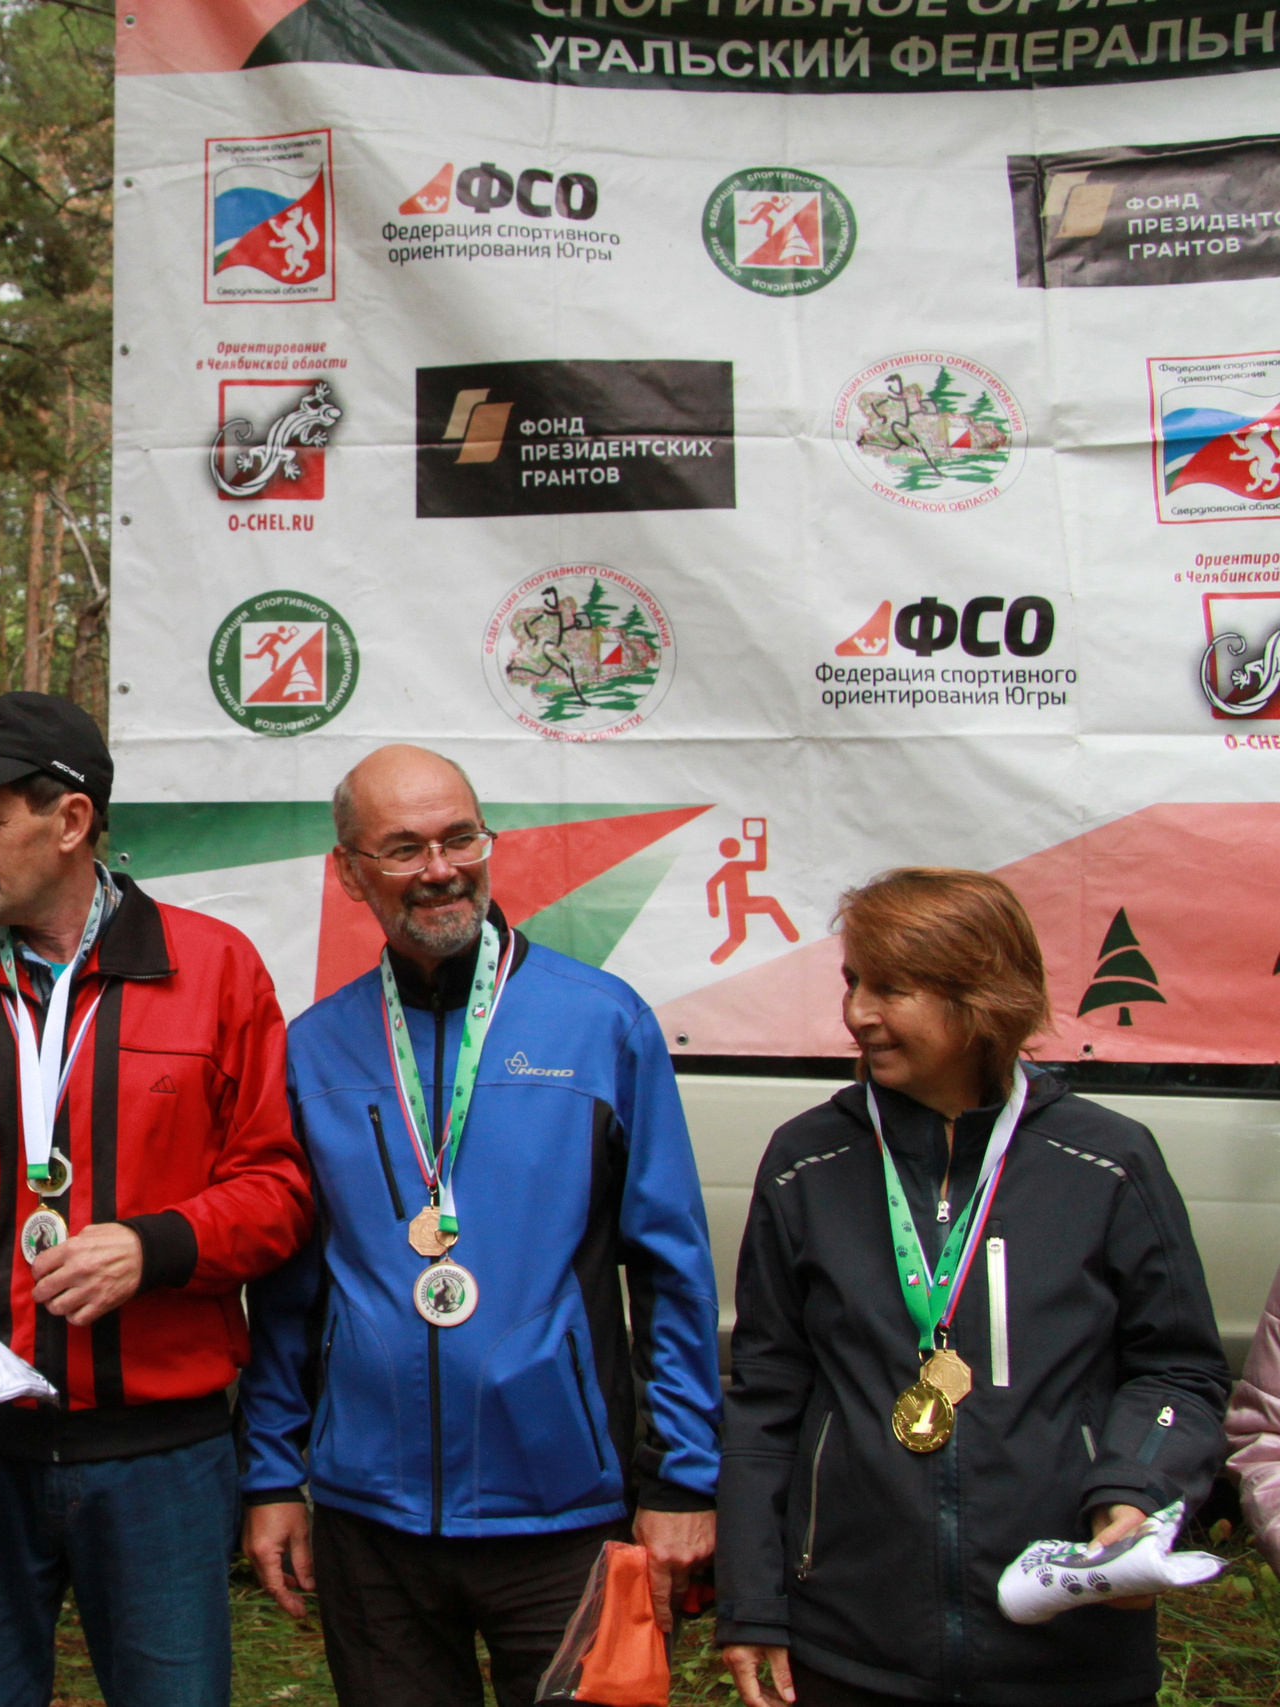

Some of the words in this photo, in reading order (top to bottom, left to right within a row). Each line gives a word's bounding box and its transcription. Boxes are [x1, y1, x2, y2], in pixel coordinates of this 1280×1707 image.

[531, 27, 870, 78] УРАЛЬСКИЙ
[890, 10, 1277, 82] ФЕДЕРАЛЬН
[456, 162, 598, 220] ФСО
[709, 180, 741, 229] ФЕДЕРАЦИЯ
[747, 171, 822, 189] СПОРТИВНОГО
[1126, 192, 1199, 210] ФОНД
[382, 222, 492, 243] Федерация
[497, 224, 620, 245] спортивного
[388, 243, 551, 267] ориентирования
[557, 242, 612, 263] Югры
[1128, 237, 1241, 260] ГРАНТОВ
[217, 341, 327, 356] Ориентирование
[196, 360, 203, 370] в
[207, 356, 289, 370] Челябинской
[292, 357, 347, 370] области
[1159, 363, 1220, 374] Федерация
[1177, 371, 1266, 384] ориентирования
[835, 378, 862, 428] ФЕДЕРАЦИЯ
[861, 353, 944, 380] СПОРТИВНОГО
[946, 356, 1022, 432] ОРИЕНТИРОВАНИЯ
[520, 417, 585, 436] ФОНД
[521, 440, 713, 461] ПРЕЗИДЕНТСКИХ
[521, 467, 620, 487] ГРАНТОВ
[872, 482, 946, 512] КУРГАНСКОЙ
[949, 486, 1001, 512] ОБЛАСТИ
[1171, 503, 1246, 515] Свердловской
[228, 514, 314, 531] O-CHEL.RU
[1195, 553, 1280, 569] Ориентиро
[1174, 573, 1181, 582] в
[1186, 567, 1280, 583] Челябинской
[485, 593, 518, 654] ФЕДЕРАЦИЯ
[519, 565, 597, 595] СПОРТИВНОГО
[599, 568, 671, 647] ОРИЕНТИРОВАНИЯ
[894, 595, 1056, 658] ФСО
[215, 611, 250, 666] ФЕДЕРАЦИЯ
[255, 597, 329, 620] СПОРТИВНОГО
[325, 623, 352, 713] ОРИЕНТИРОВАНИЯ
[815, 662, 935, 686] Федерация
[941, 669, 1077, 687] спортивного
[216, 674, 246, 716] ОБЛАСТИ
[822, 688, 999, 708] ориентирования
[1005, 686, 1066, 709] Югры
[254, 713, 321, 731] ТЮМЕНСКОЙ
[517, 713, 587, 743] КУРГАНСКОЙ
[590, 713, 643, 742] ОБЛАСТИ
[517, 1067, 574, 1077] NORD
